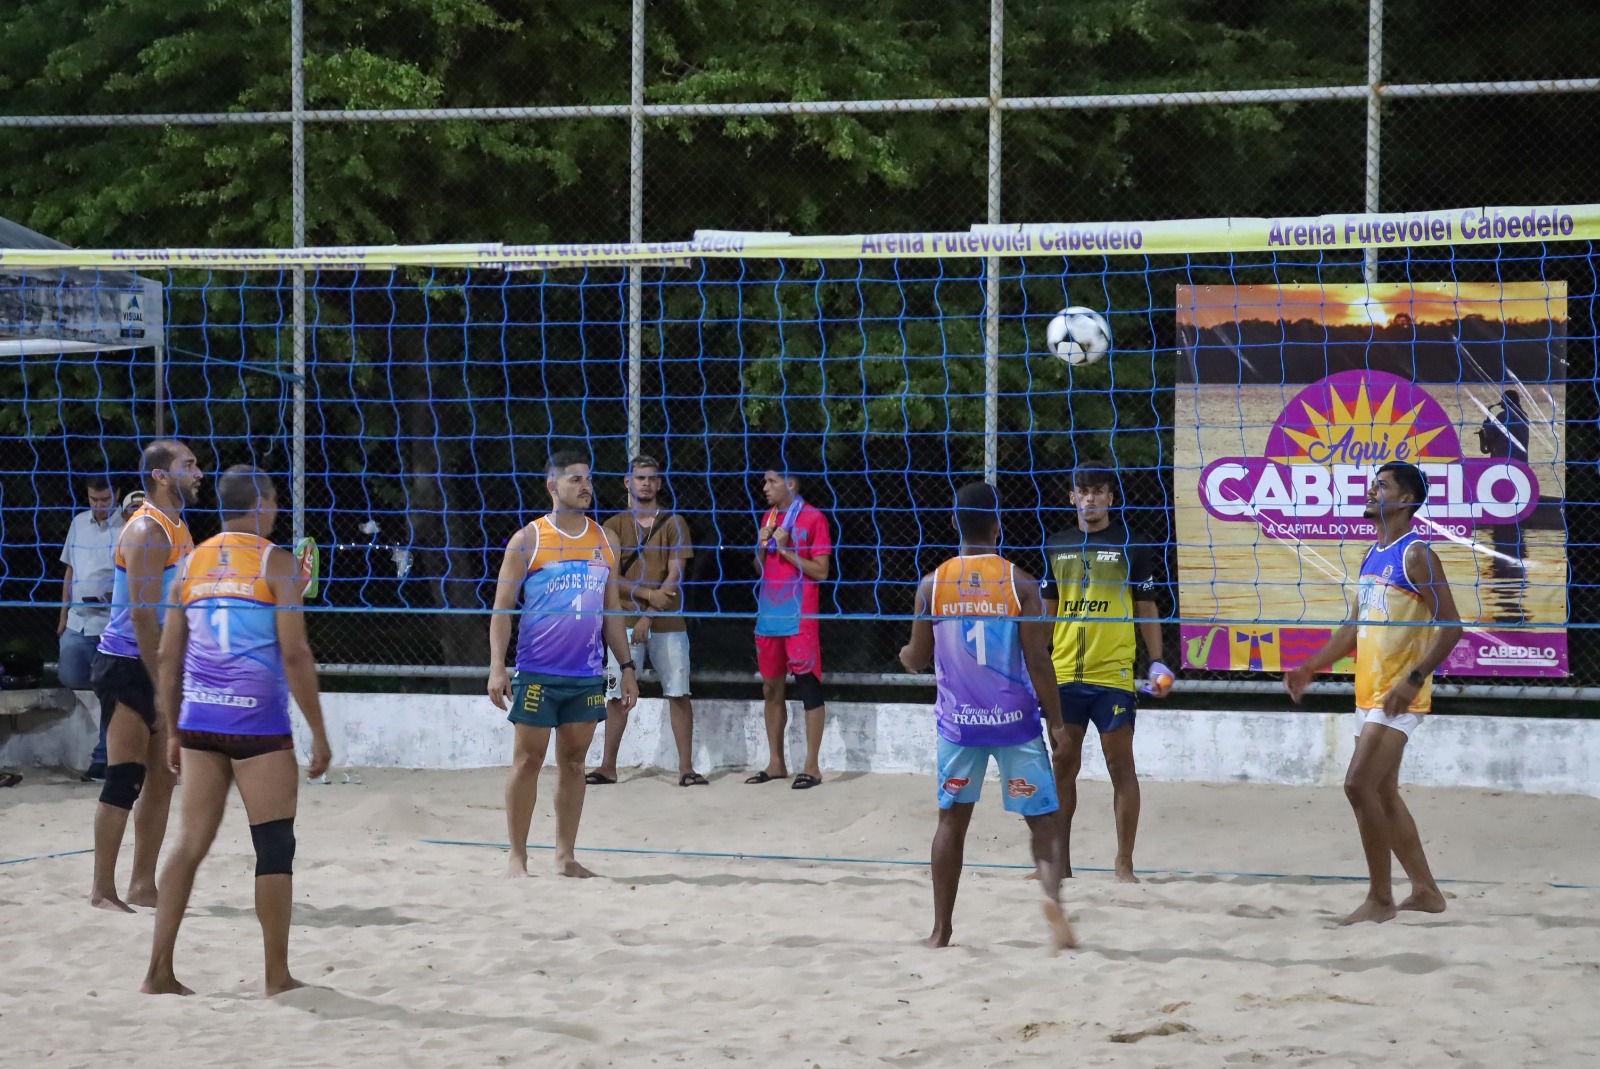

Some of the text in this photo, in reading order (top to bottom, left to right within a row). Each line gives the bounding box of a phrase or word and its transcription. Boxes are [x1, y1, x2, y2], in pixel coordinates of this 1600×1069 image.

[861, 233, 925, 254] Arena
[1039, 224, 1143, 251] Cabedelo
[1268, 218, 1337, 247] Arena
[1460, 207, 1575, 241] Cabedelo
[1308, 425, 1392, 470] Aqui
[1206, 462, 1533, 518] CABEELO
[1266, 523, 1276, 535] A
[1278, 523, 1327, 535] CAPITAL
[1329, 523, 1349, 535] DO
[571, 572, 583, 589] DE
[571, 593, 582, 620] 1
[942, 599, 1009, 616] FUTEVÔLEI
[210, 598, 231, 653] 1
[966, 618, 987, 666] 1
[1478, 645, 1557, 660] CABEDELO
[951, 709, 1024, 726] TRABALHO
